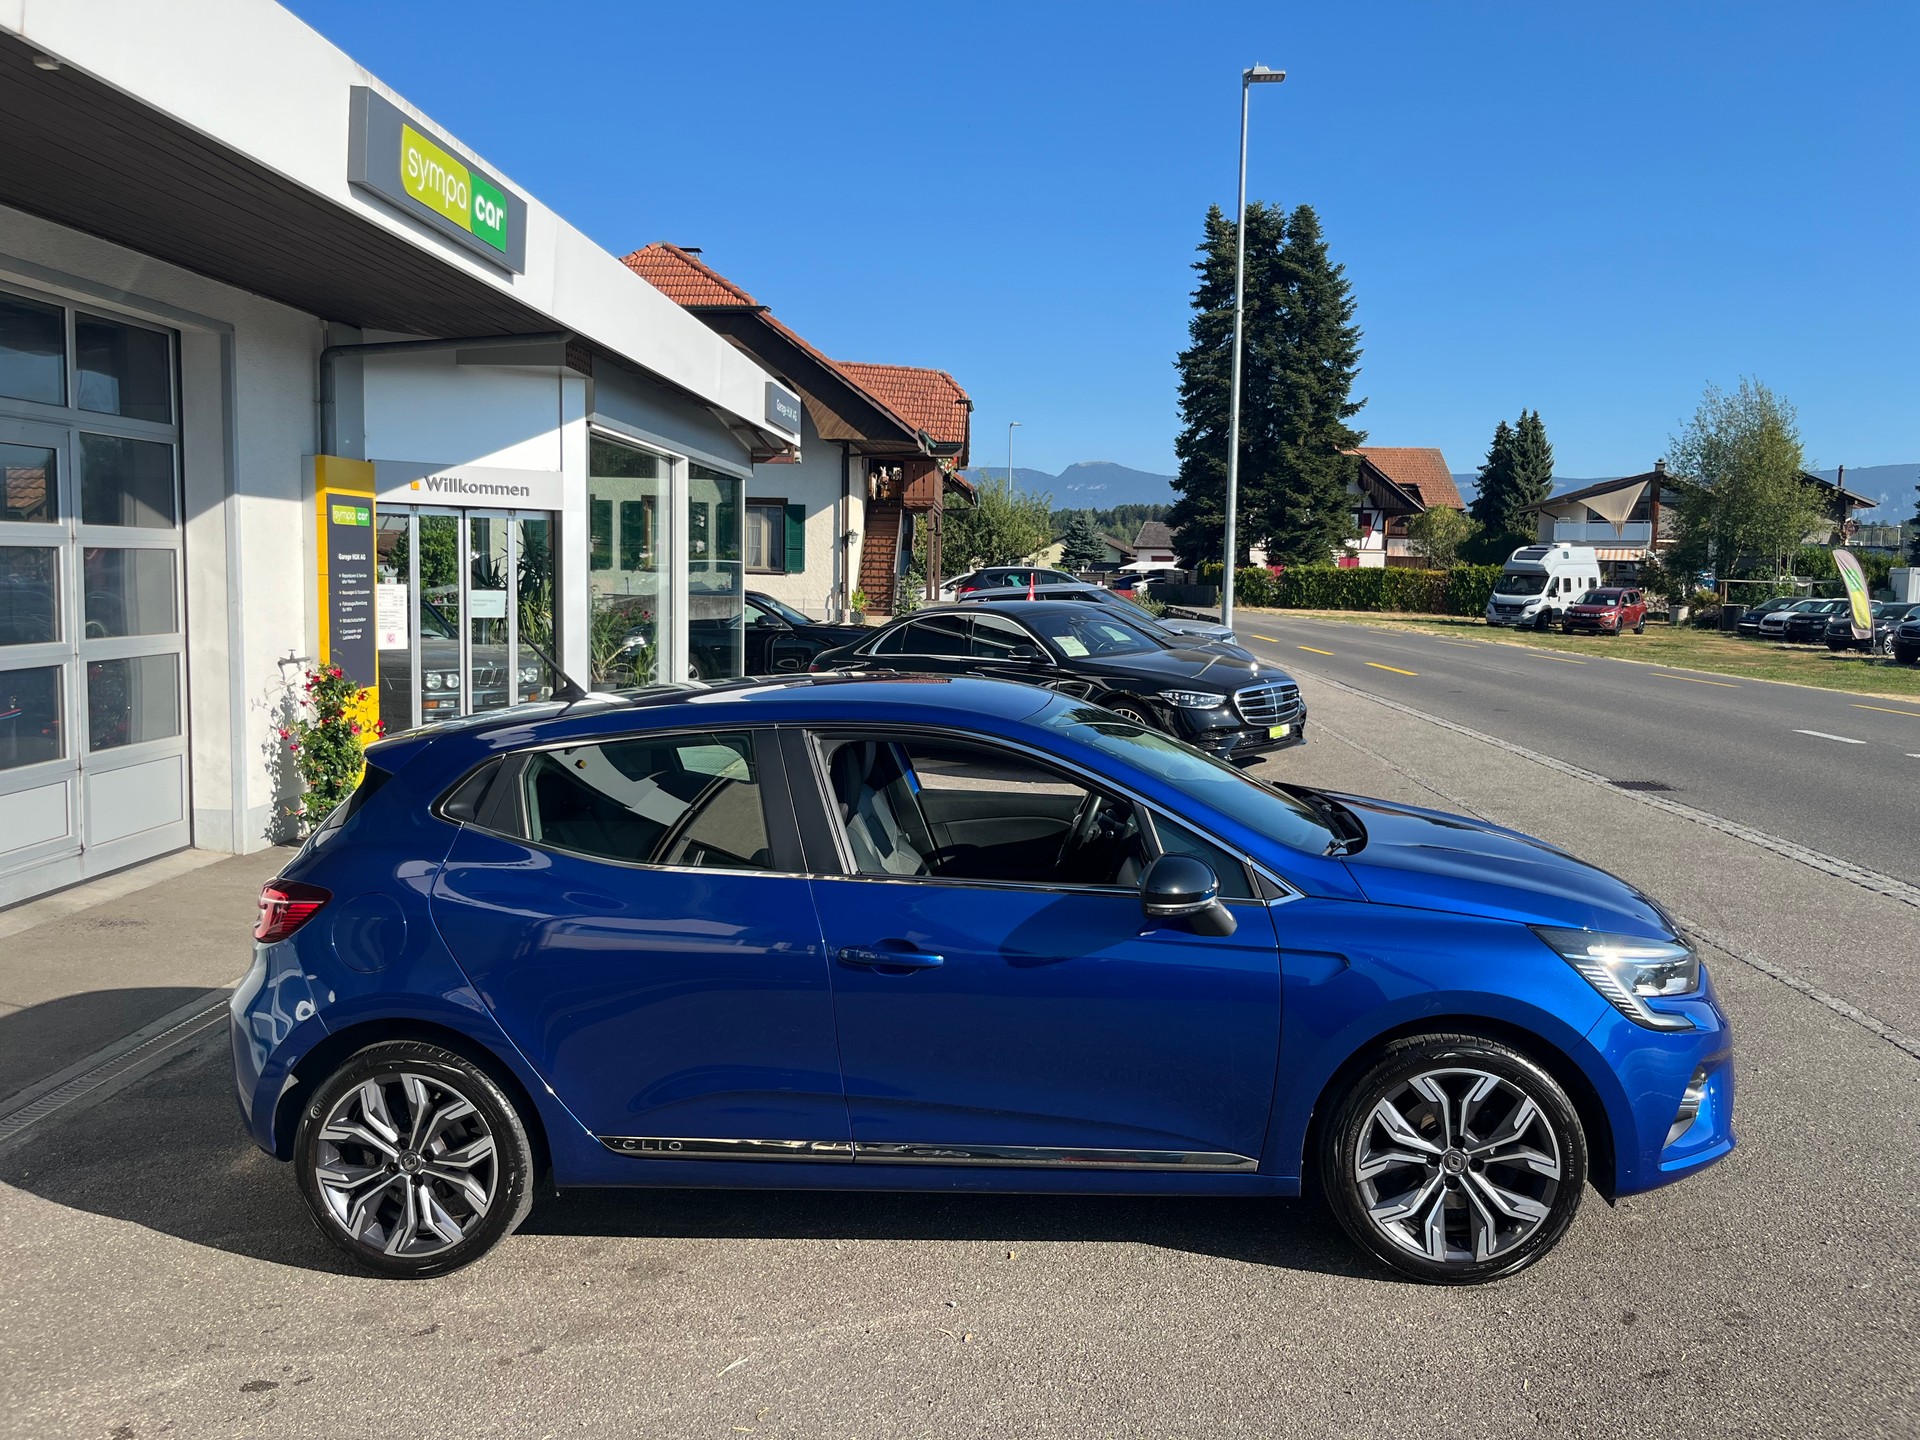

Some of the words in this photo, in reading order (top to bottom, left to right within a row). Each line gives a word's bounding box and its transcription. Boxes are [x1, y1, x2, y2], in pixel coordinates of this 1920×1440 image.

[407, 147, 467, 211] sympa
[474, 194, 504, 231] car
[424, 475, 530, 497] Willkommen
[334, 511, 355, 522] sympa
[357, 512, 369, 521] car
[622, 1140, 683, 1151] CLIO
